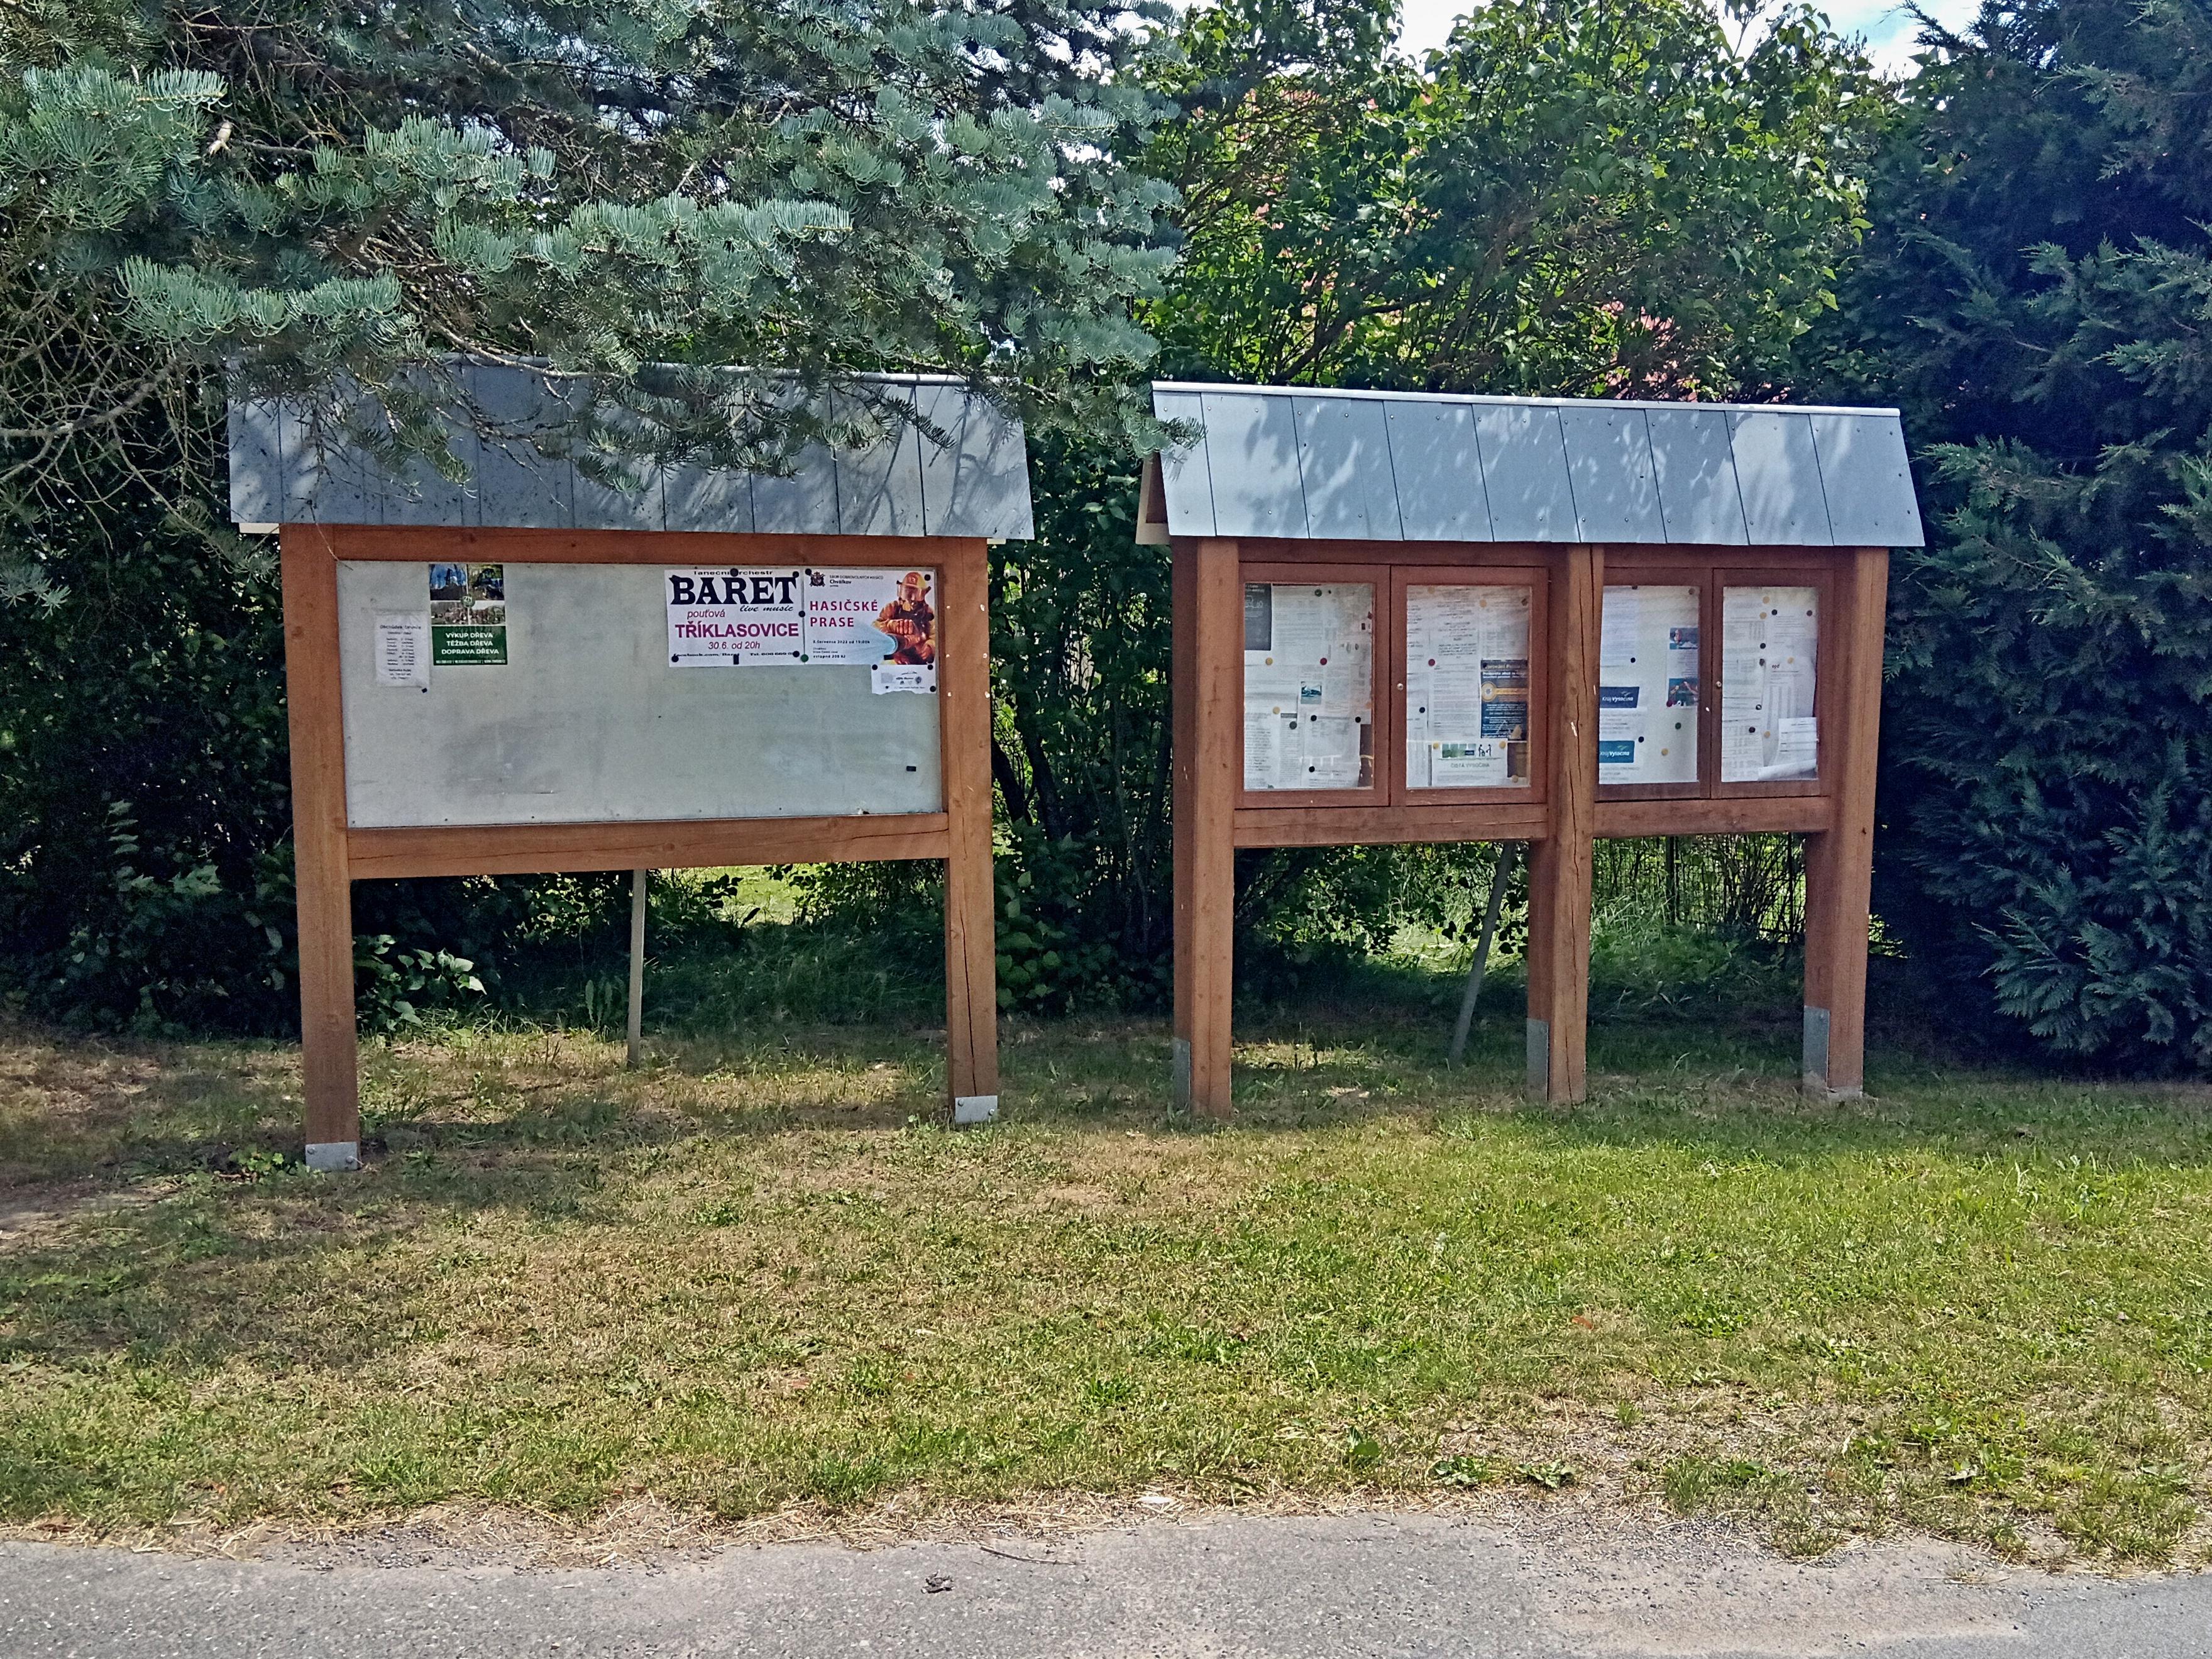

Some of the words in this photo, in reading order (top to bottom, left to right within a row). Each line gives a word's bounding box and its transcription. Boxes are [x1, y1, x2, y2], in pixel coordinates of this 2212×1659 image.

[669, 575, 797, 605] BARET
[810, 599, 878, 612] HASIČSKÉ
[687, 609, 725, 619] pouťová
[810, 617, 854, 627] PRASE
[675, 620, 799, 638] TŘÍKLASOVICE
[732, 641, 742, 649] od
